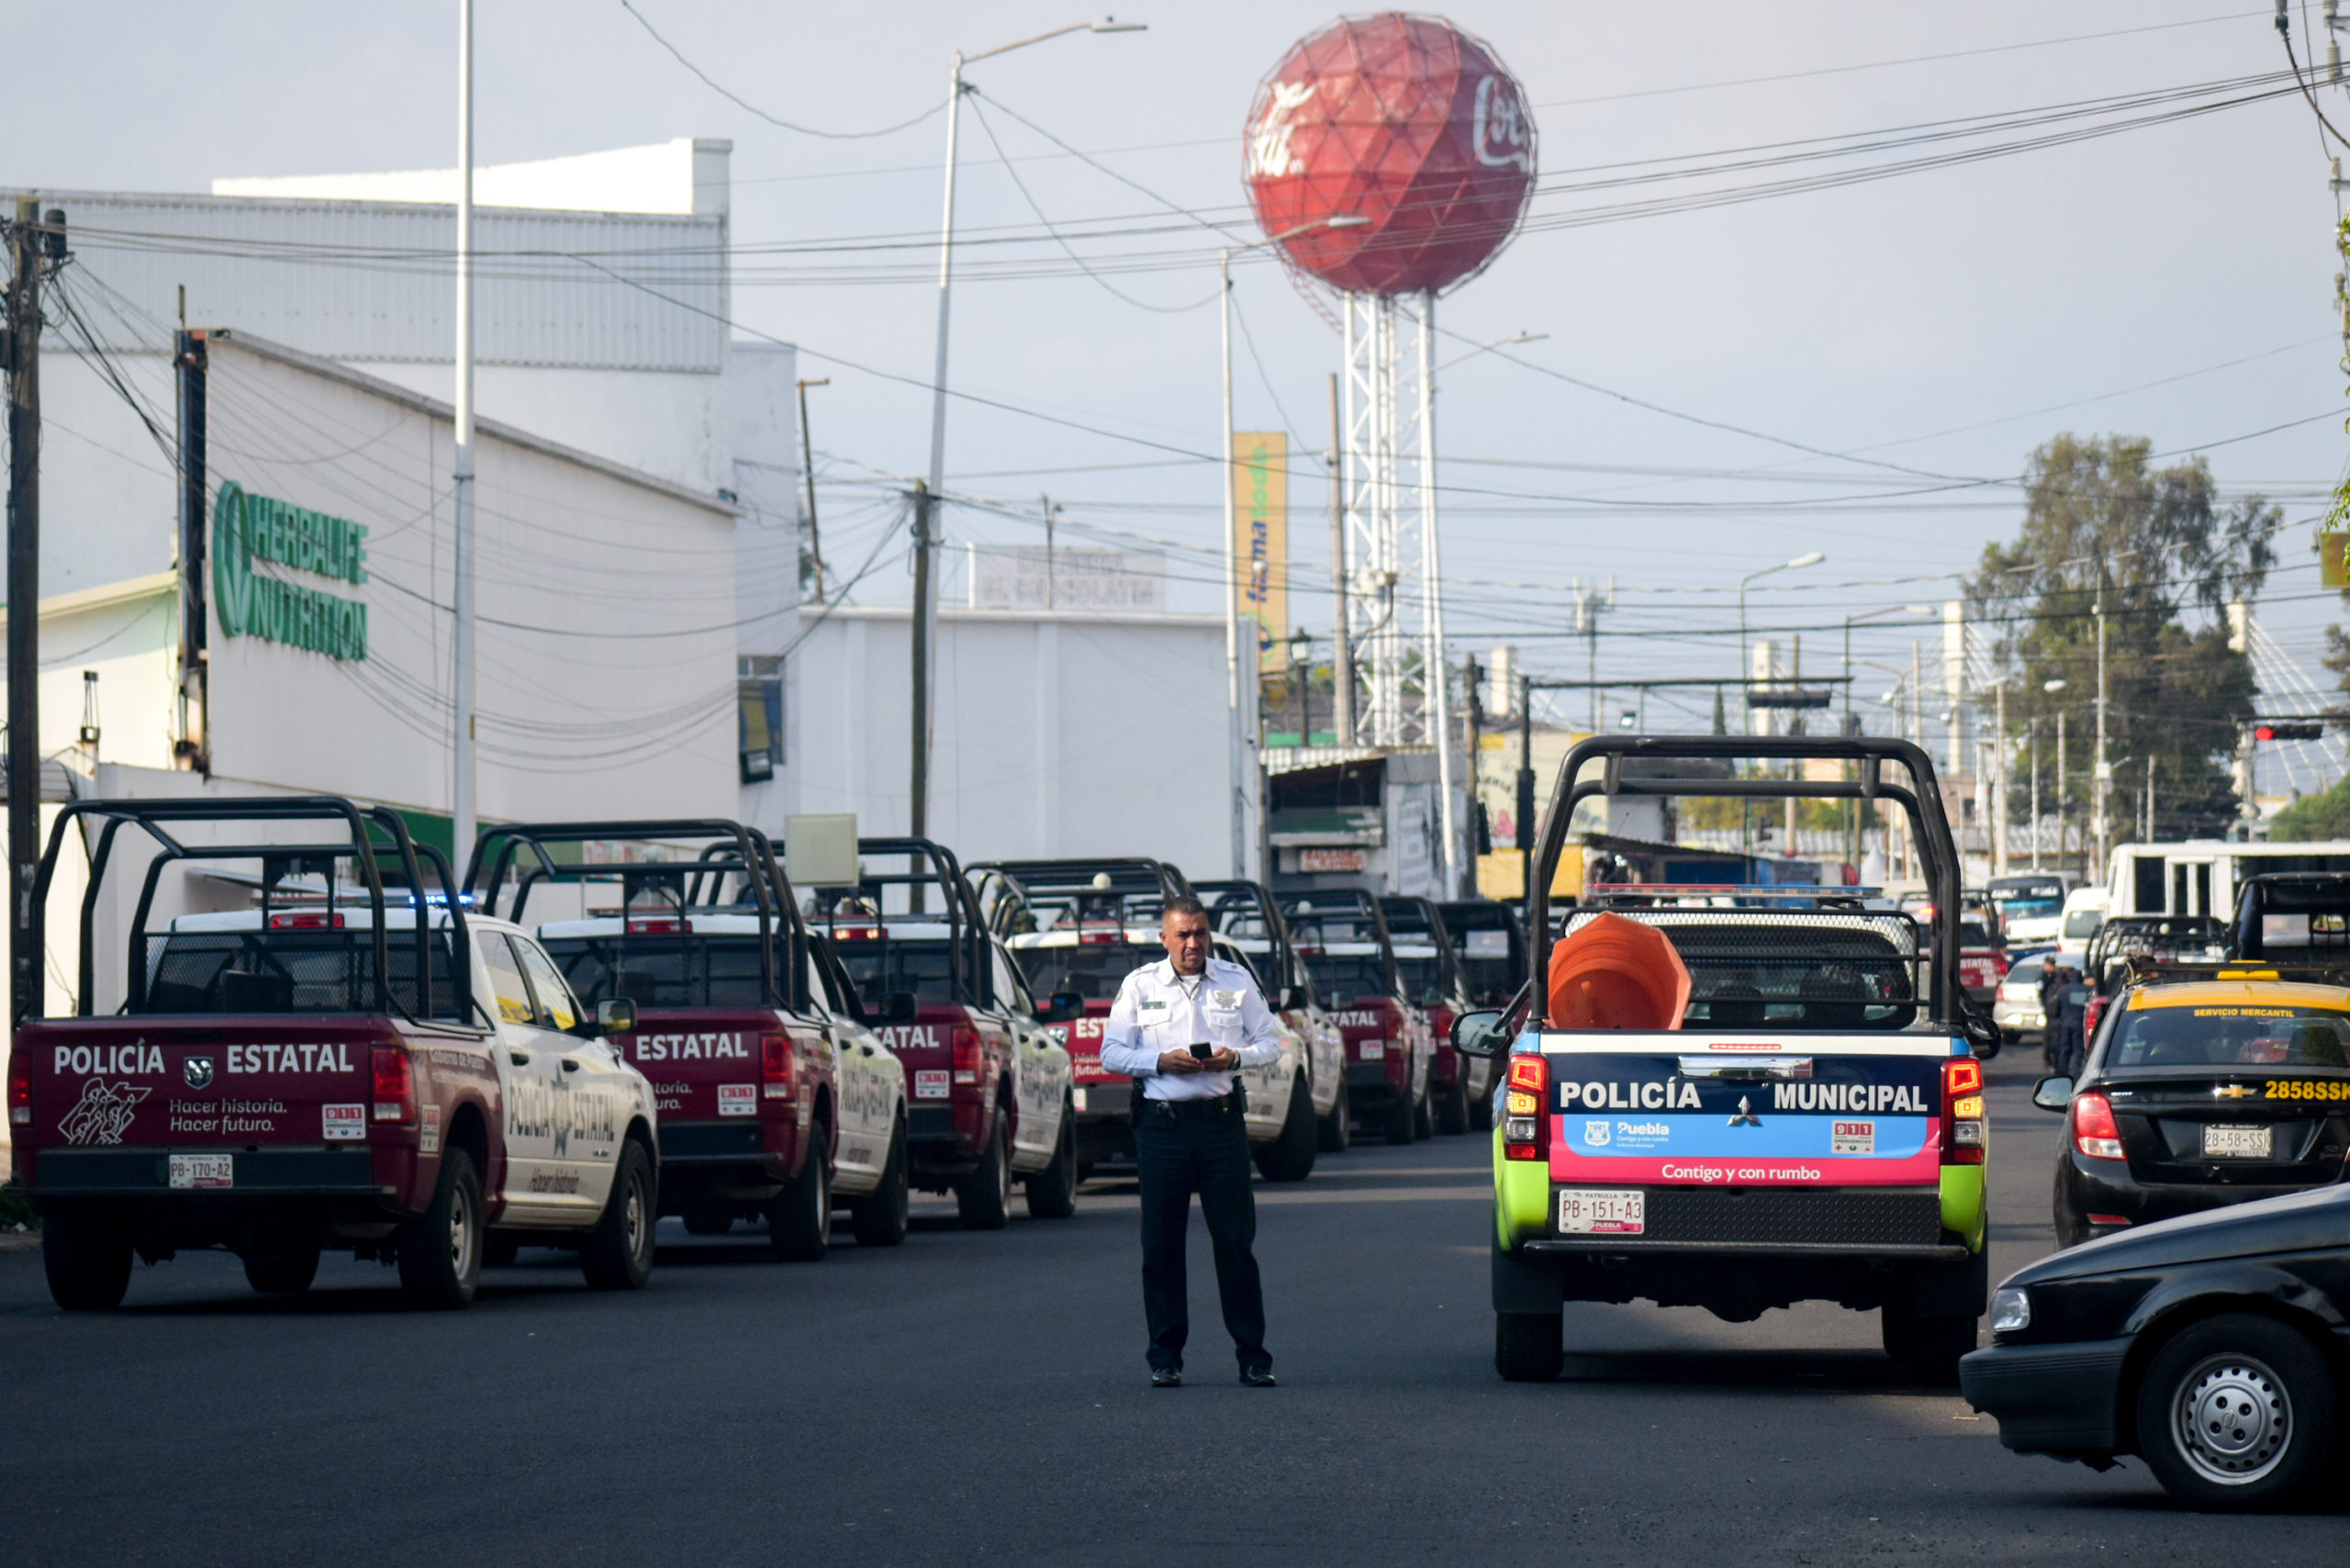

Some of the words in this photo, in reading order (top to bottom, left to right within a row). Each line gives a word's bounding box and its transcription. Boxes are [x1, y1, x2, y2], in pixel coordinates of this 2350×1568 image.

[247, 574, 367, 661] NUTRITION
[2194, 1008, 2238, 1017] SERVICIO
[2240, 1008, 2295, 1018] MERCANTIL
[636, 1033, 749, 1060] ESTATAL
[53, 1036, 166, 1075] POLICÍA
[227, 1043, 354, 1074] ESTATAL
[1560, 1076, 1702, 1109] POLICÍA
[1774, 1082, 1929, 1113] MUNICIPAL
[169, 1099, 218, 1113] Hacer
[222, 1099, 287, 1114] historia.
[328, 1107, 362, 1119] 911
[170, 1115, 218, 1132] Hacer
[222, 1115, 274, 1135] futuro.
[1617, 1121, 1670, 1136] Puebla
[1837, 1125, 1870, 1135] 911
[2205, 1133, 2270, 1148] 28-58-SSK
[171, 1162, 230, 1177] PB-170-A2
[1662, 1164, 1722, 1182] Contigo
[1726, 1168, 1735, 1182] y
[1738, 1168, 1765, 1179] con
[1769, 1166, 1820, 1180] rumbo
[1563, 1200, 1641, 1219] PB-151-A3
